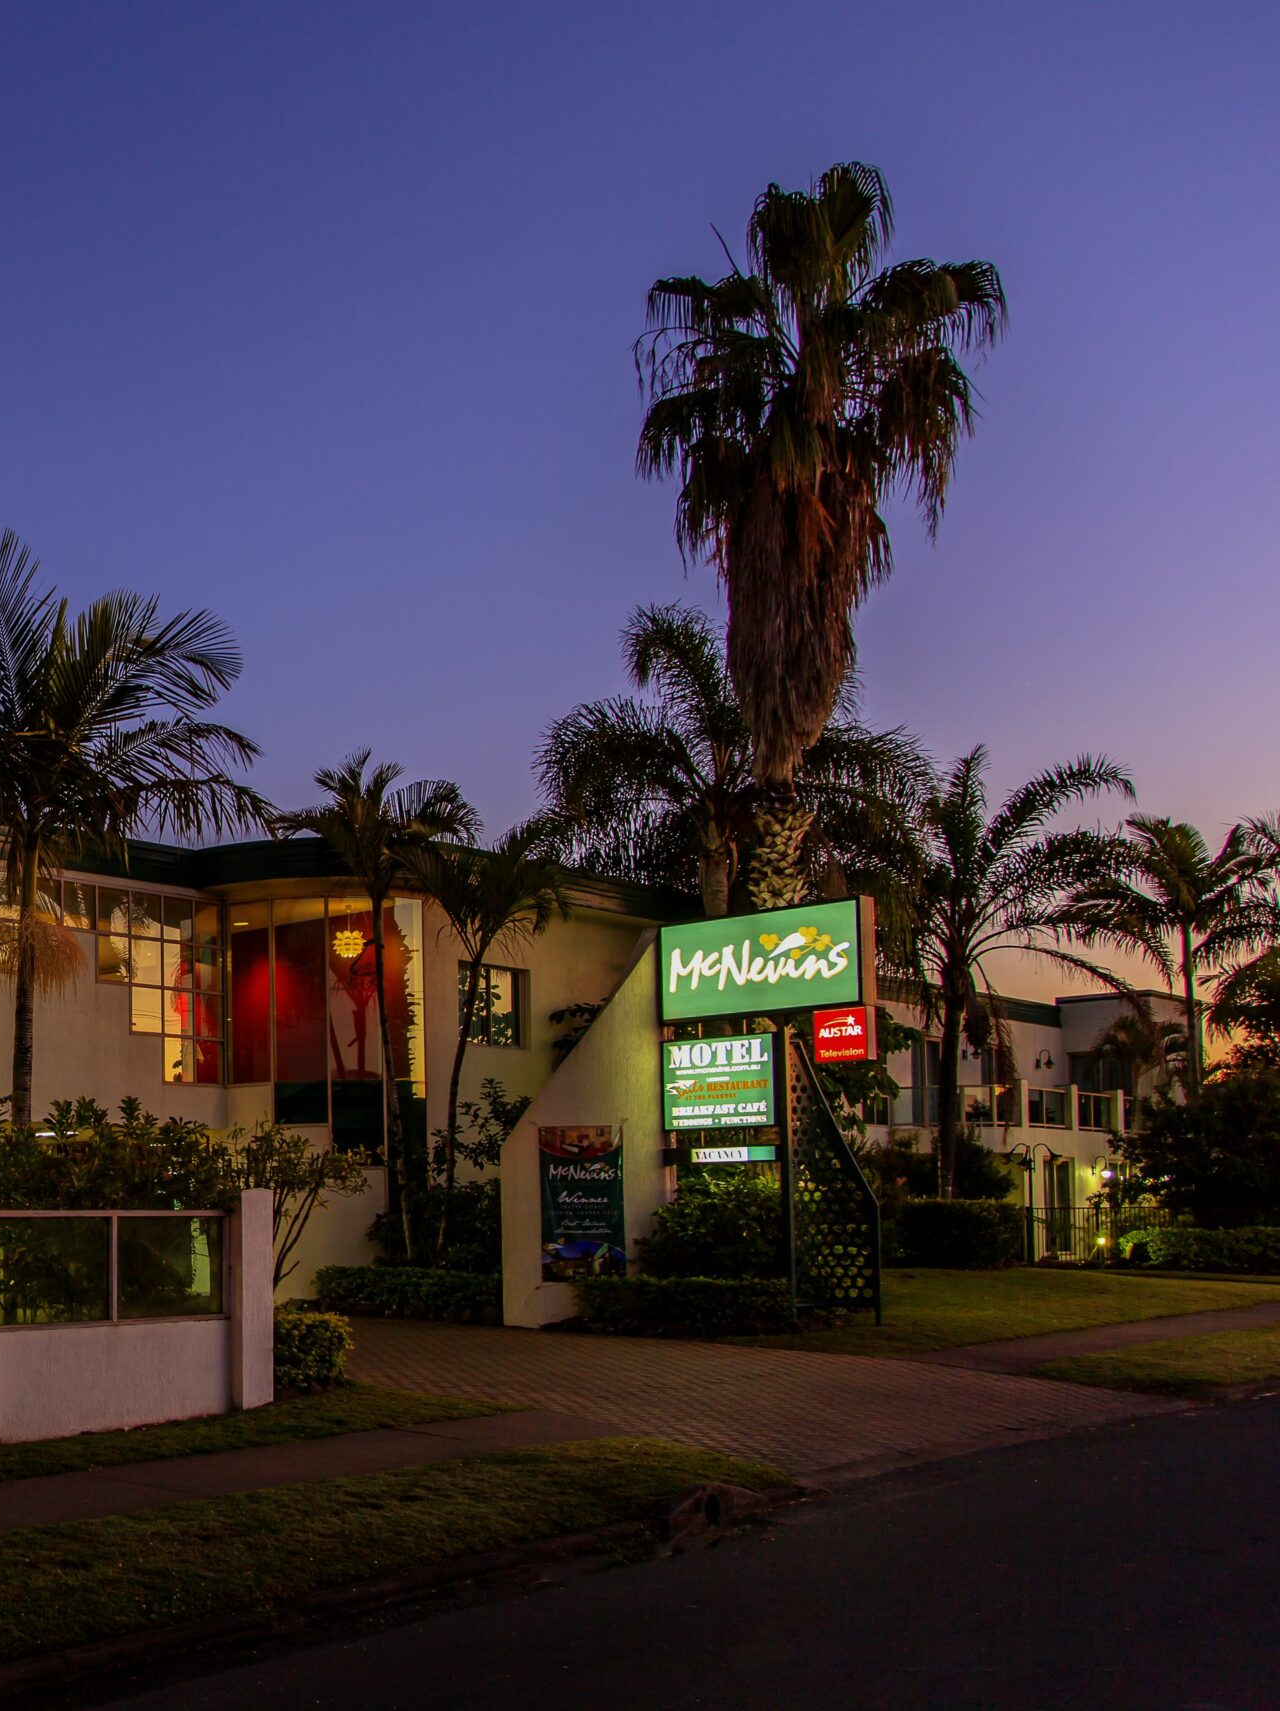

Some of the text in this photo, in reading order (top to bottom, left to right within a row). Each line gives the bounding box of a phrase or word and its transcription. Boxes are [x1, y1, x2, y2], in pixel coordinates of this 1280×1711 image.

[669, 938, 850, 993] McNevins
[819, 1025, 863, 1039] AUSTAR
[668, 1039, 768, 1069] MOTEL
[819, 1047, 864, 1058] Television
[706, 1079, 768, 1092] RESTAURANT
[672, 1100, 767, 1117] BREAKFAST CAFÉ
[672, 1115, 767, 1126] WEDDINGS FUNCTIONS
[694, 1149, 743, 1160] VACANCY
[549, 1163, 616, 1181] McNevins
[556, 1190, 609, 1203] Winner
